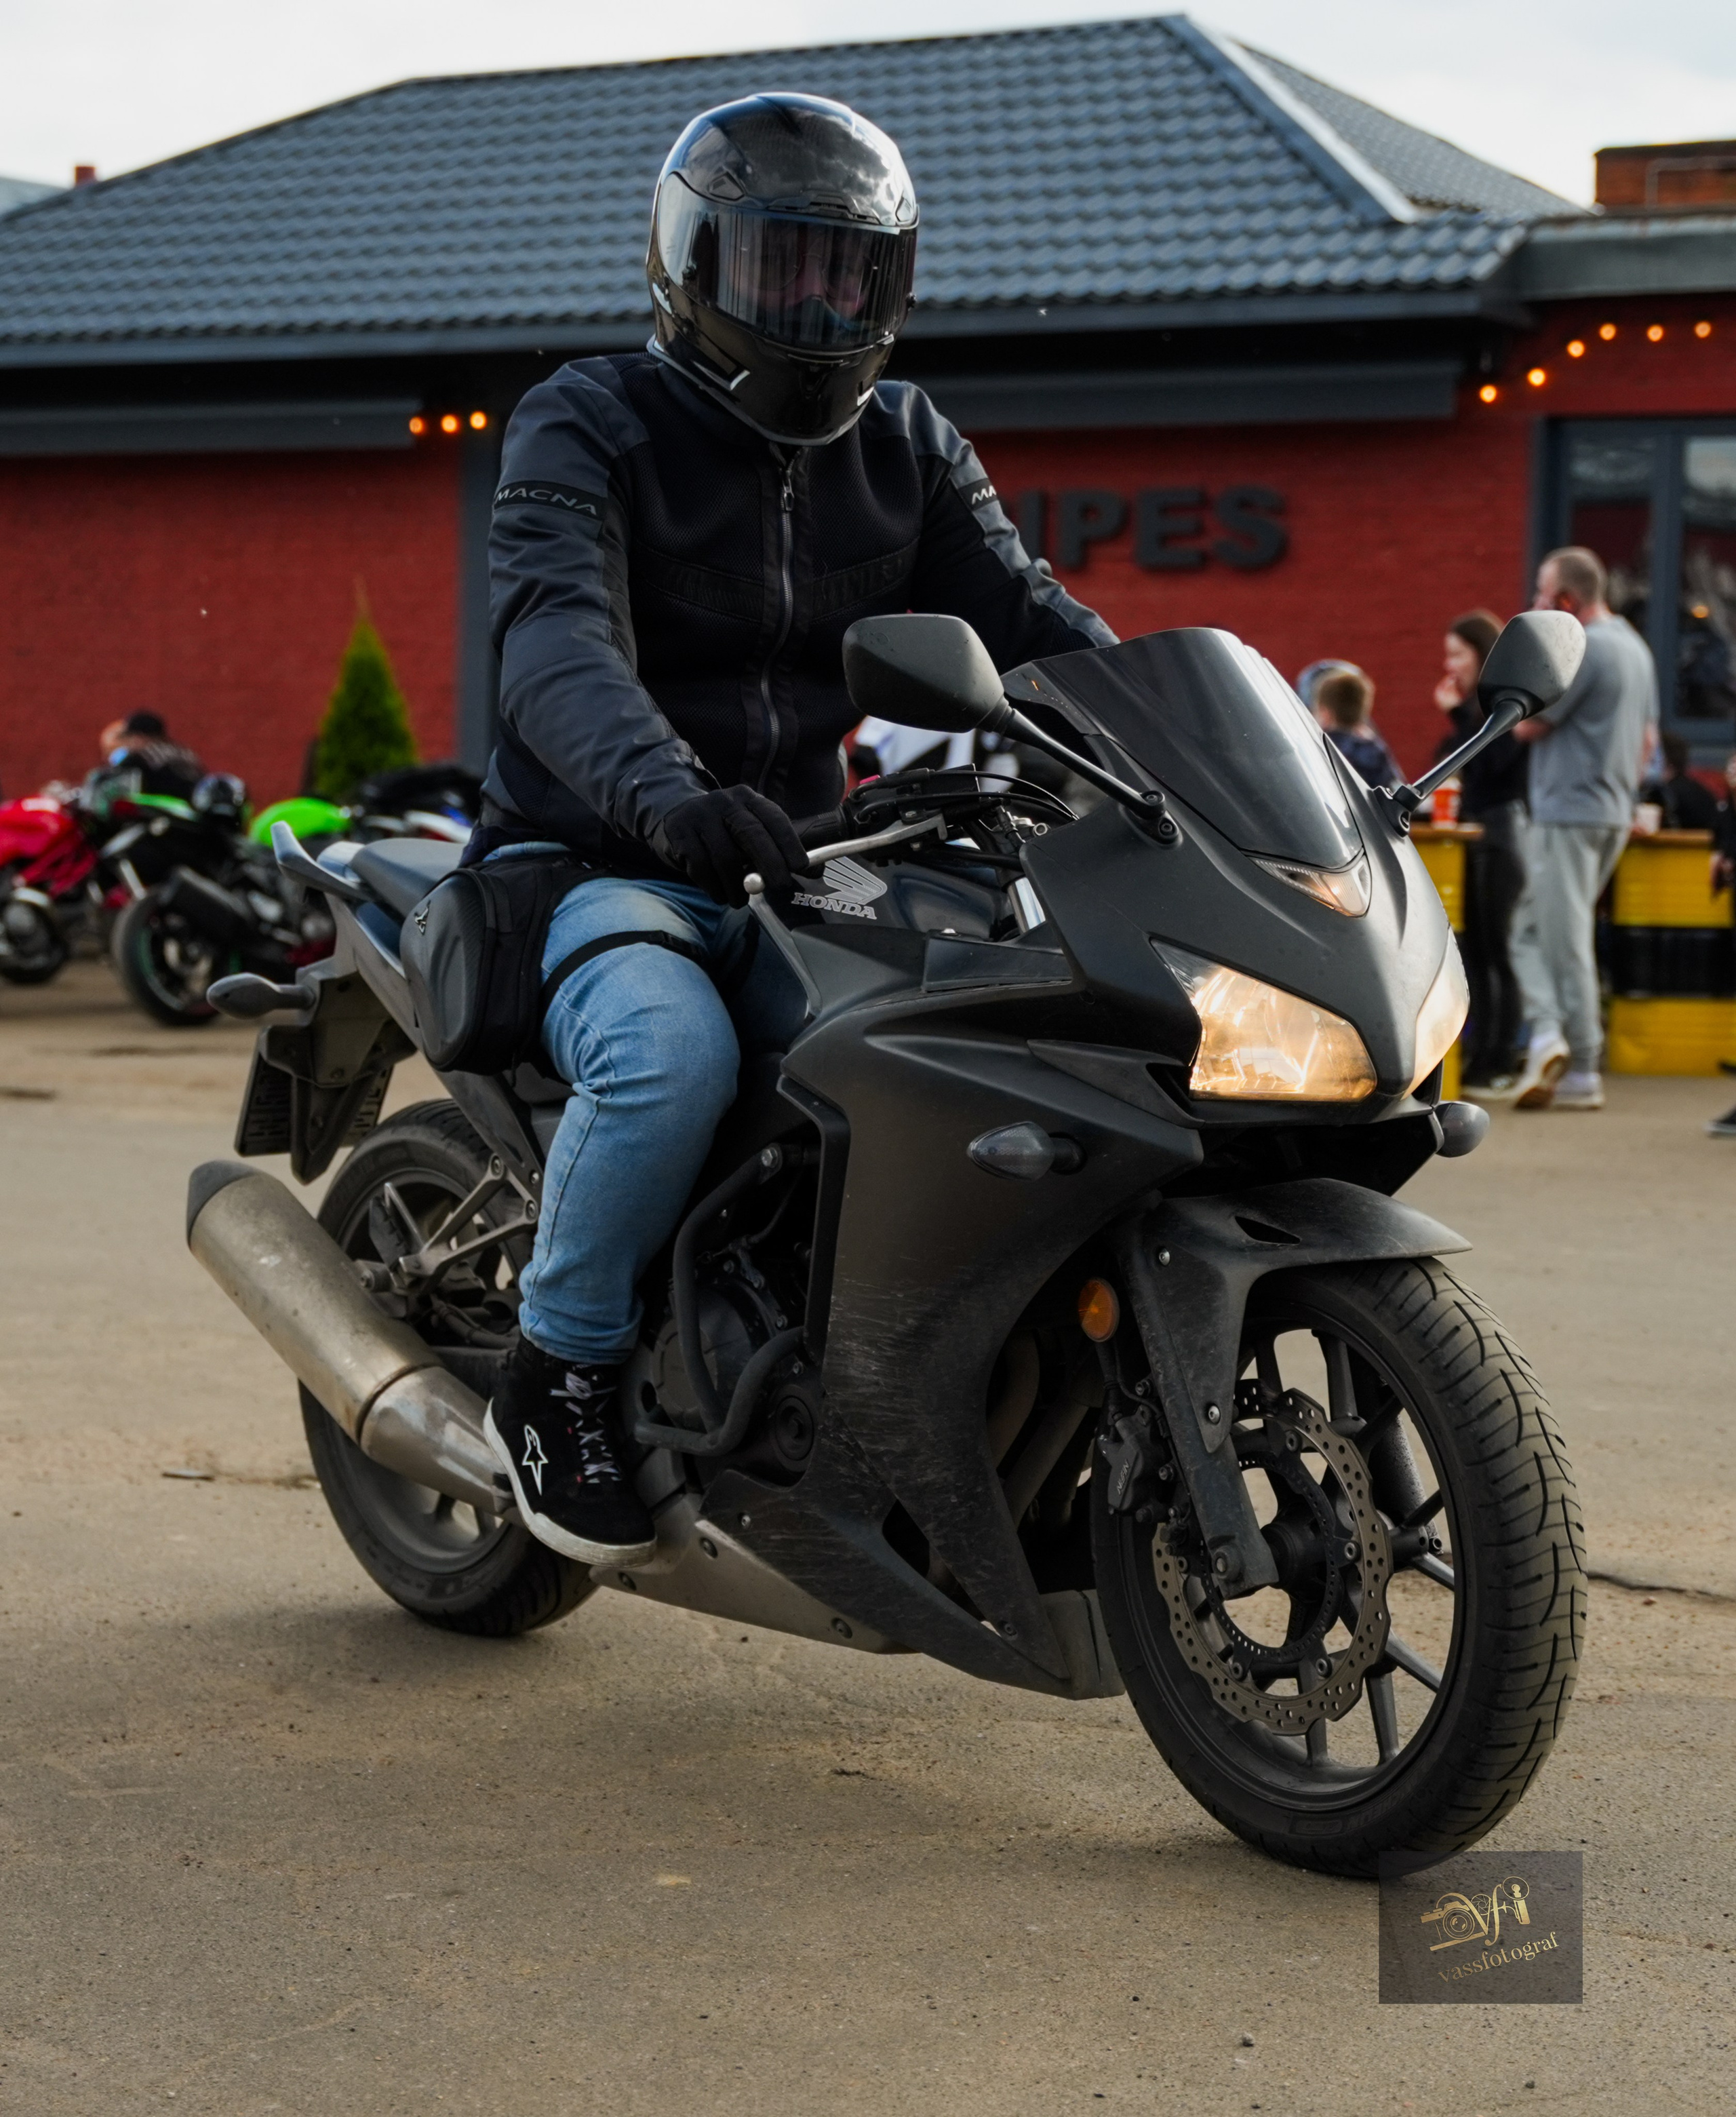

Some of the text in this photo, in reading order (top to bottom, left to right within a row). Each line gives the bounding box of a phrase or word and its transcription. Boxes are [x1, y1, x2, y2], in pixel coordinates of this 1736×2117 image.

[494, 488, 597, 516] MACNA
[1002, 486, 1288, 570] IPES
[791, 892, 877, 920] HONDA
